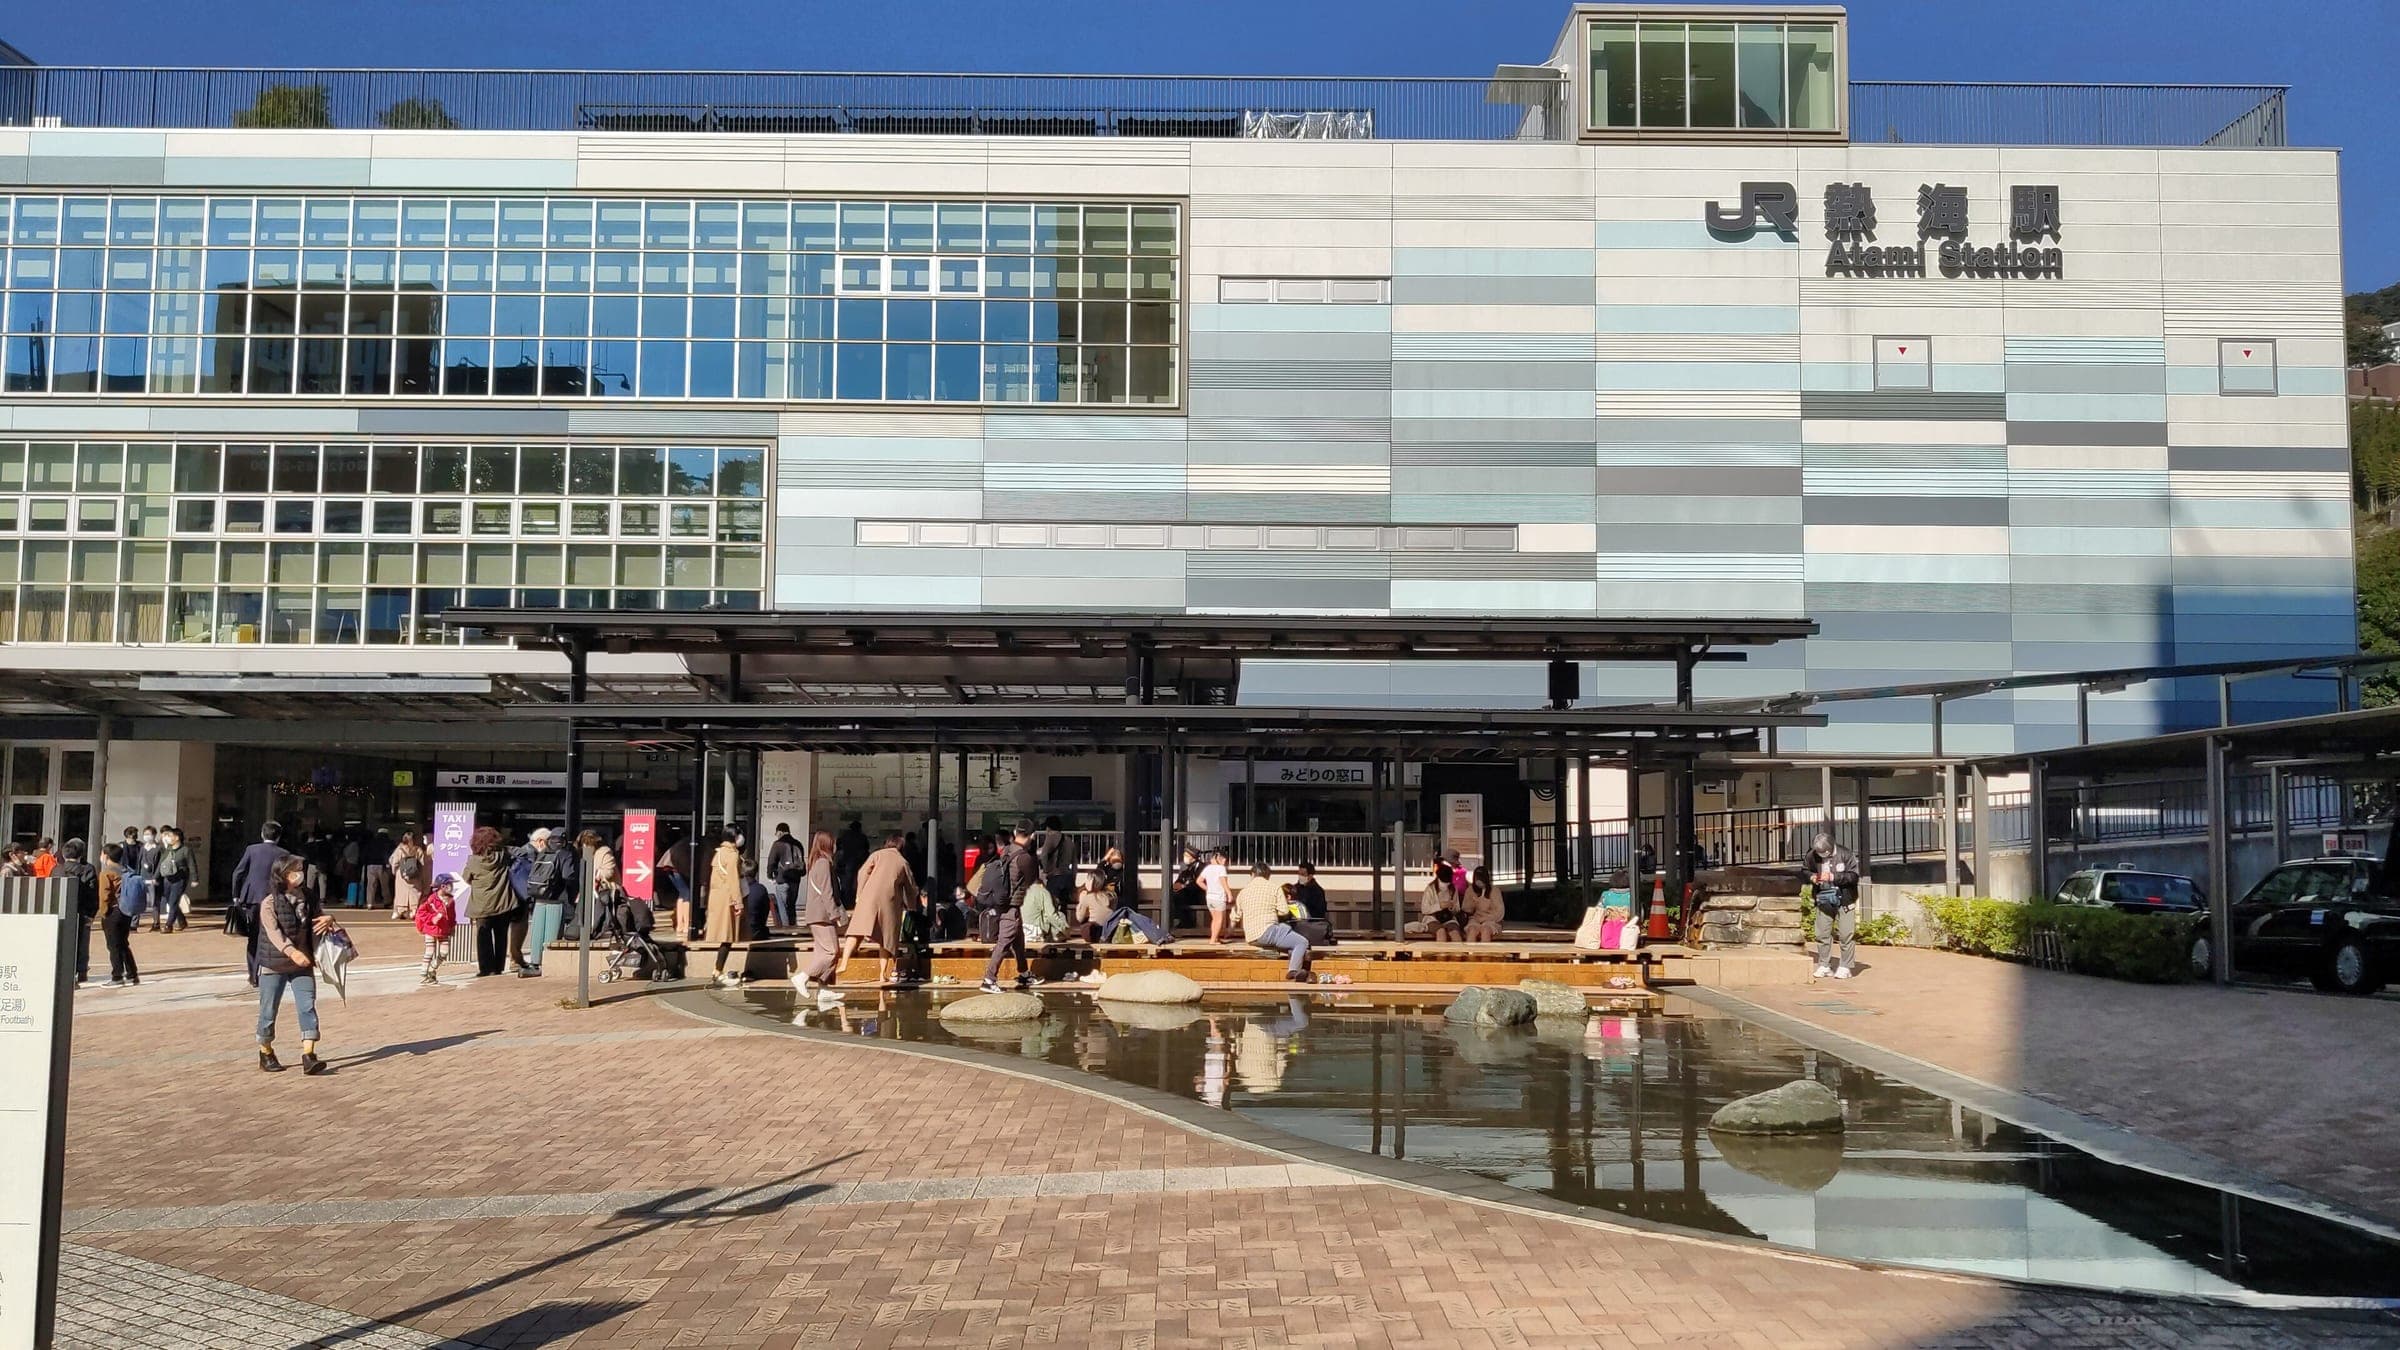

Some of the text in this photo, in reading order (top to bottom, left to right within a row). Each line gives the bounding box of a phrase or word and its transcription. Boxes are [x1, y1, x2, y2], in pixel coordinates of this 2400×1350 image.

[1705, 182, 1799, 233] JR
[1825, 240, 2063, 271] Atami Station
[451, 774, 469, 785] JR
[1280, 768, 1364, 783] みどりの窓口
[442, 814, 466, 823] TAXI
[440, 843, 468, 851] タクシー
